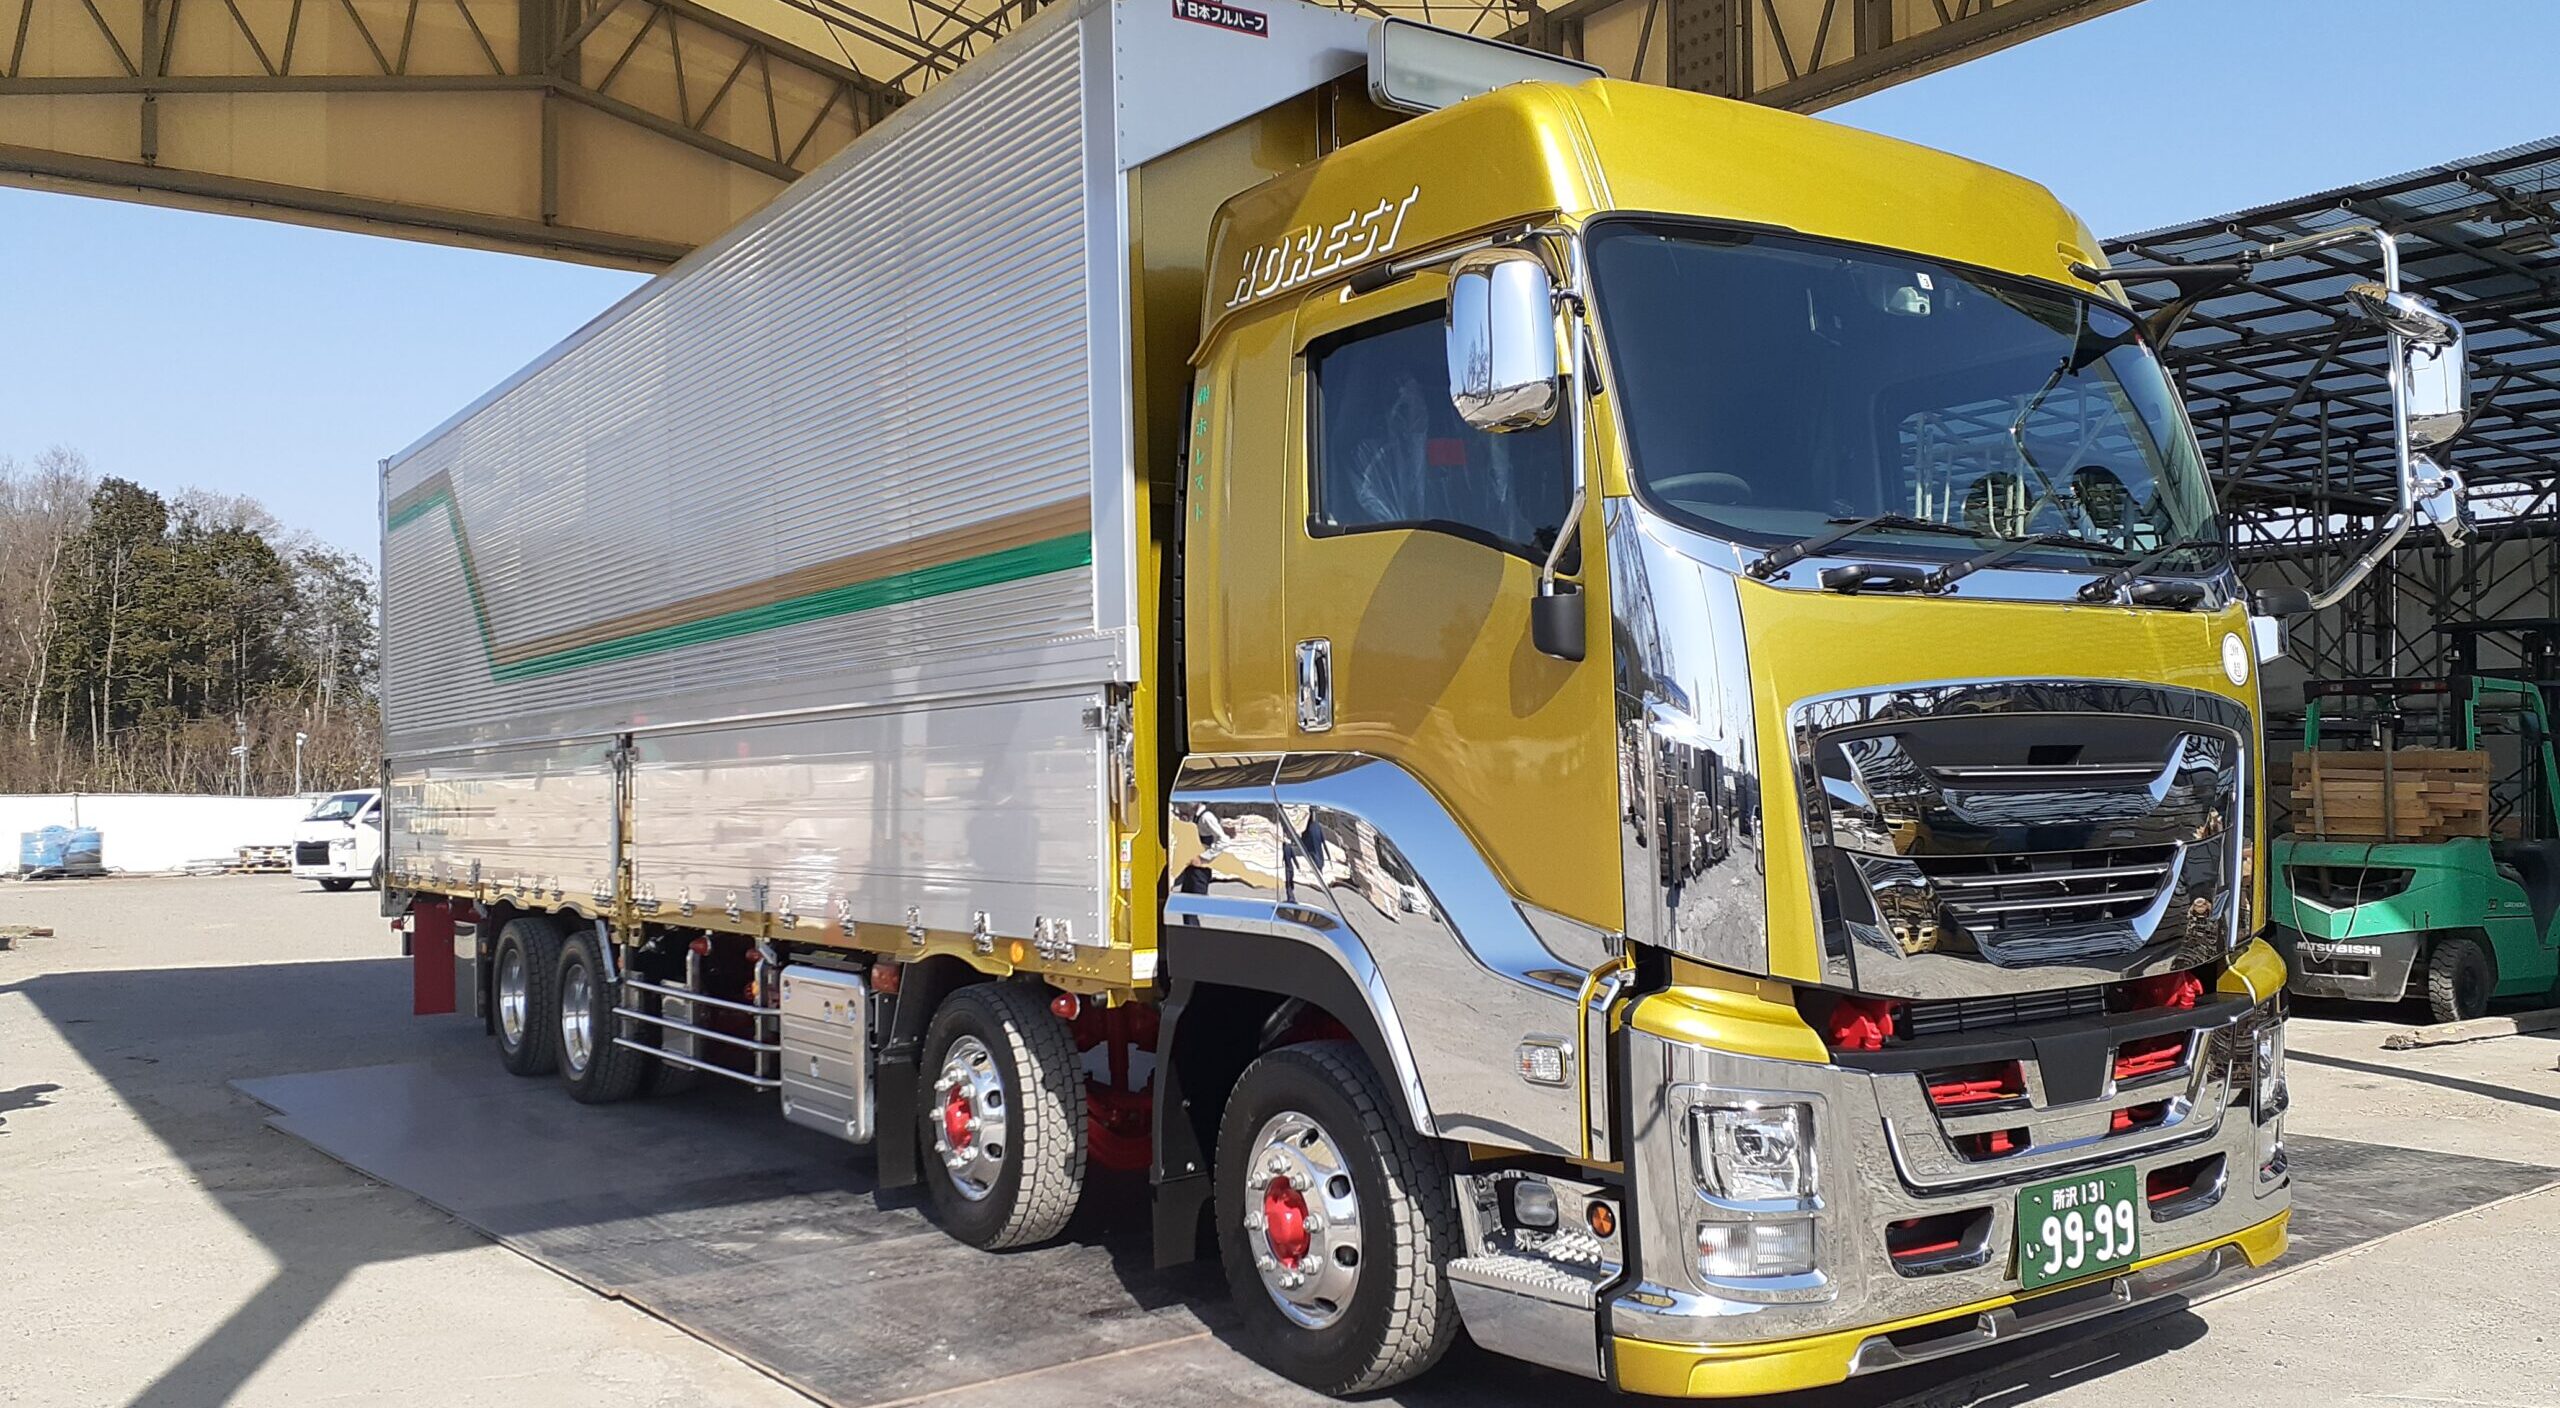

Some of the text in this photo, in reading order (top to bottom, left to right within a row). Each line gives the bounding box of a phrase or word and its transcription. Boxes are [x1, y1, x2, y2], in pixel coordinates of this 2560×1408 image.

[1187, 2, 1265, 31] 日本フルハーフ
[1224, 184, 1421, 308] HOREST
[2296, 941, 2382, 955] MITSUBISHI
[2052, 1179, 2105, 1211] 所沢 131
[2026, 1199, 2135, 1275] い 99-99
